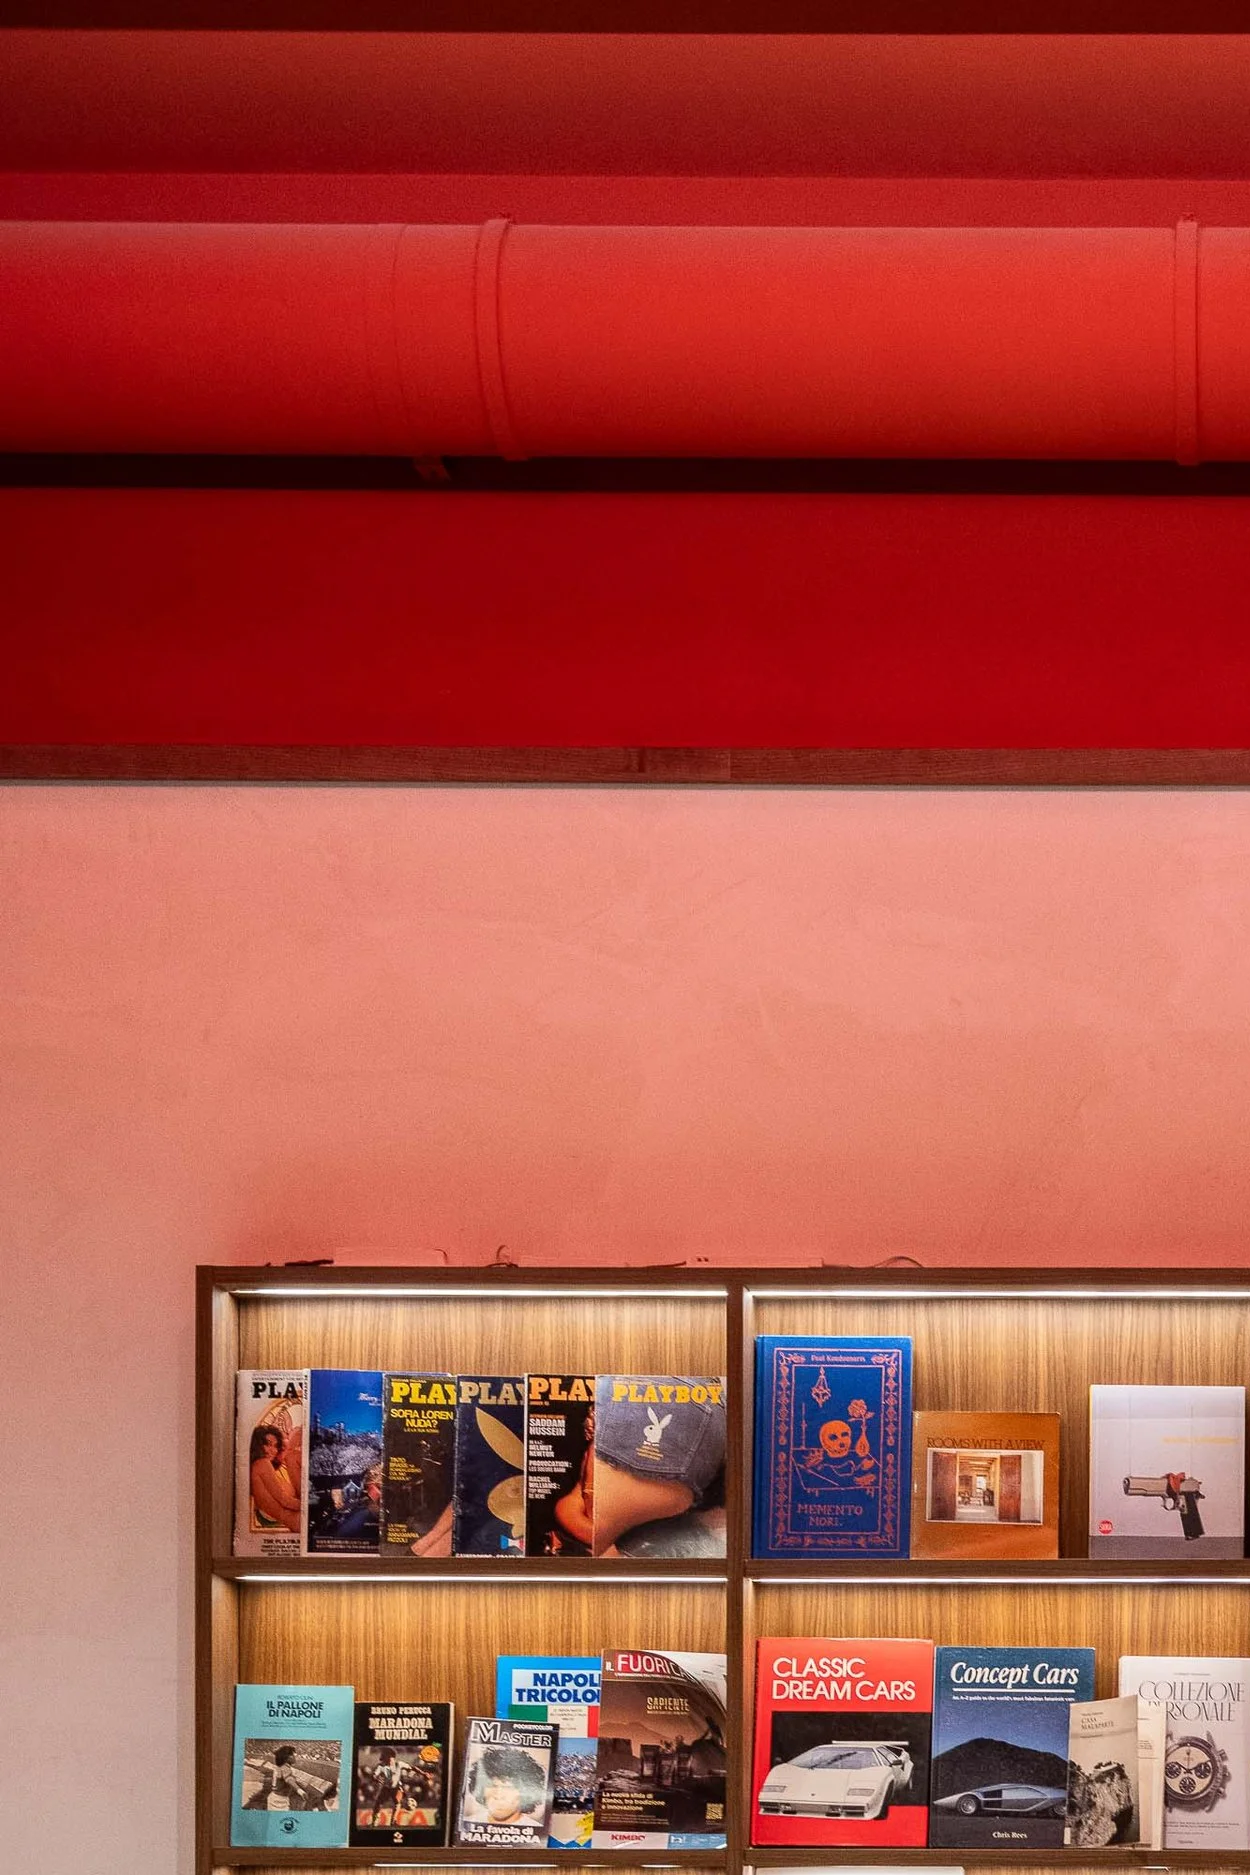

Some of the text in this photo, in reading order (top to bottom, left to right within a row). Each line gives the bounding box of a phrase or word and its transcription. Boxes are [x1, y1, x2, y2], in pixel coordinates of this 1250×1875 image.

[252, 1382, 303, 1399] PLA
[612, 1384, 722, 1404] PLAYBOY
[390, 1408, 454, 1420] SOFIA LOREN
[405, 1419, 438, 1428] NUDA?
[529, 1418, 566, 1428] SADDAM
[529, 1427, 566, 1437] HUSSEIN
[926, 1437, 971, 1448] ROOMS
[971, 1438, 1002, 1449] WITH
[1014, 1440, 1045, 1450] VIEW
[797, 1504, 863, 1516] MEMENTO
[772, 1657, 866, 1678] CLASSIC
[950, 1661, 1080, 1689] Concept Cars
[515, 1688, 600, 1703] TRICOLO
[772, 1680, 916, 1701] DREAM CARS
[1138, 1681, 1246, 1702] COLLEZIONE
[266, 1701, 324, 1710] IL PALLONE
[371, 1706, 397, 1715] BRUNO
[1148, 1701, 1235, 1721] RSONALE
[269, 1709, 321, 1719] DI NAPOLI
[368, 1717, 434, 1729] MARADONA
[374, 1729, 428, 1740] MUNDIAL
[471, 1720, 552, 1747] MASTER
[470, 1823, 534, 1836] La favola di
[992, 1831, 1010, 1839] Chris
[460, 1832, 541, 1844] MARADONA
